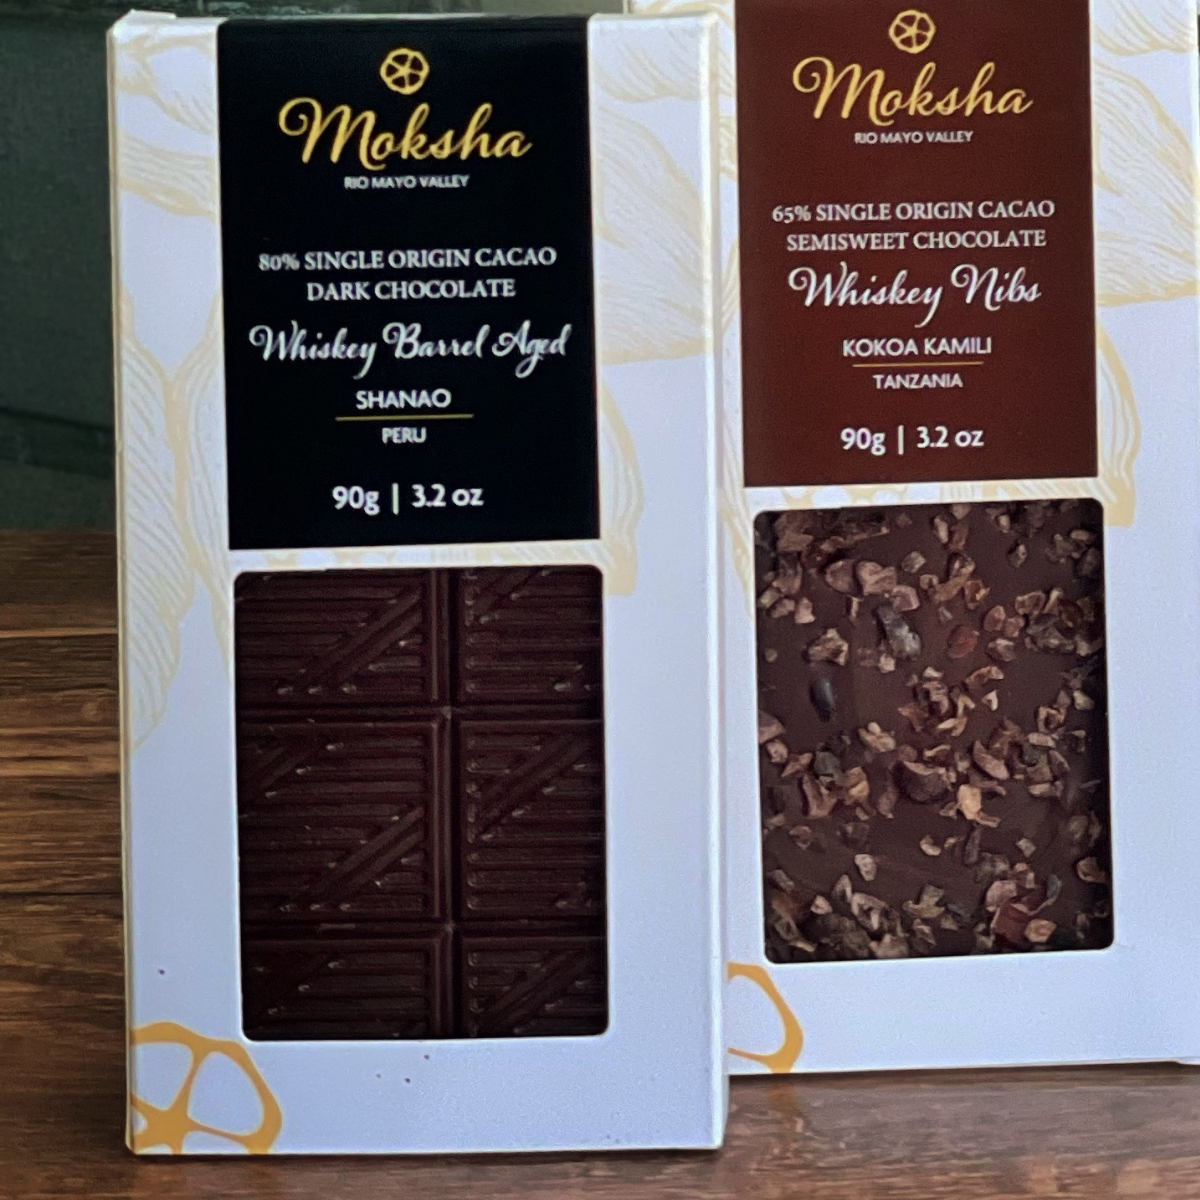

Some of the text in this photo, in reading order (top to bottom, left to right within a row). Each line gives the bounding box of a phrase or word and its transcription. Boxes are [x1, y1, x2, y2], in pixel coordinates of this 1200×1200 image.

[792, 55, 1034, 127] Moksha
[278, 97, 532, 171] Moksha
[854, 130, 974, 145] RIO MAYO VALLEY
[343, 174, 470, 190] RIO MAYO VALLEY
[771, 199, 1055, 224] 65% SINGLE ORIGIN CACAO
[786, 229, 1047, 252] SEMISWEET CHOCOLATE
[258, 246, 557, 271] 80% SINGLE ORIGIN CACAO
[306, 278, 516, 302] DARK CHOCOLATE
[788, 261, 1042, 328] Whiskey Nibs
[248, 319, 572, 380] Whiskey Barrel Aged
[842, 336, 992, 357] KOKOA KAMILI
[872, 372, 964, 390] TANZANIA
[355, 388, 452, 410] SHANAO
[381, 426, 427, 444] PERU
[840, 427, 886, 456] 90g
[916, 425, 949, 449] 3.2
[954, 430, 985, 448] oz
[332, 485, 380, 516] 90g
[411, 483, 447, 508] 3.2
[451, 488, 484, 507] oz
